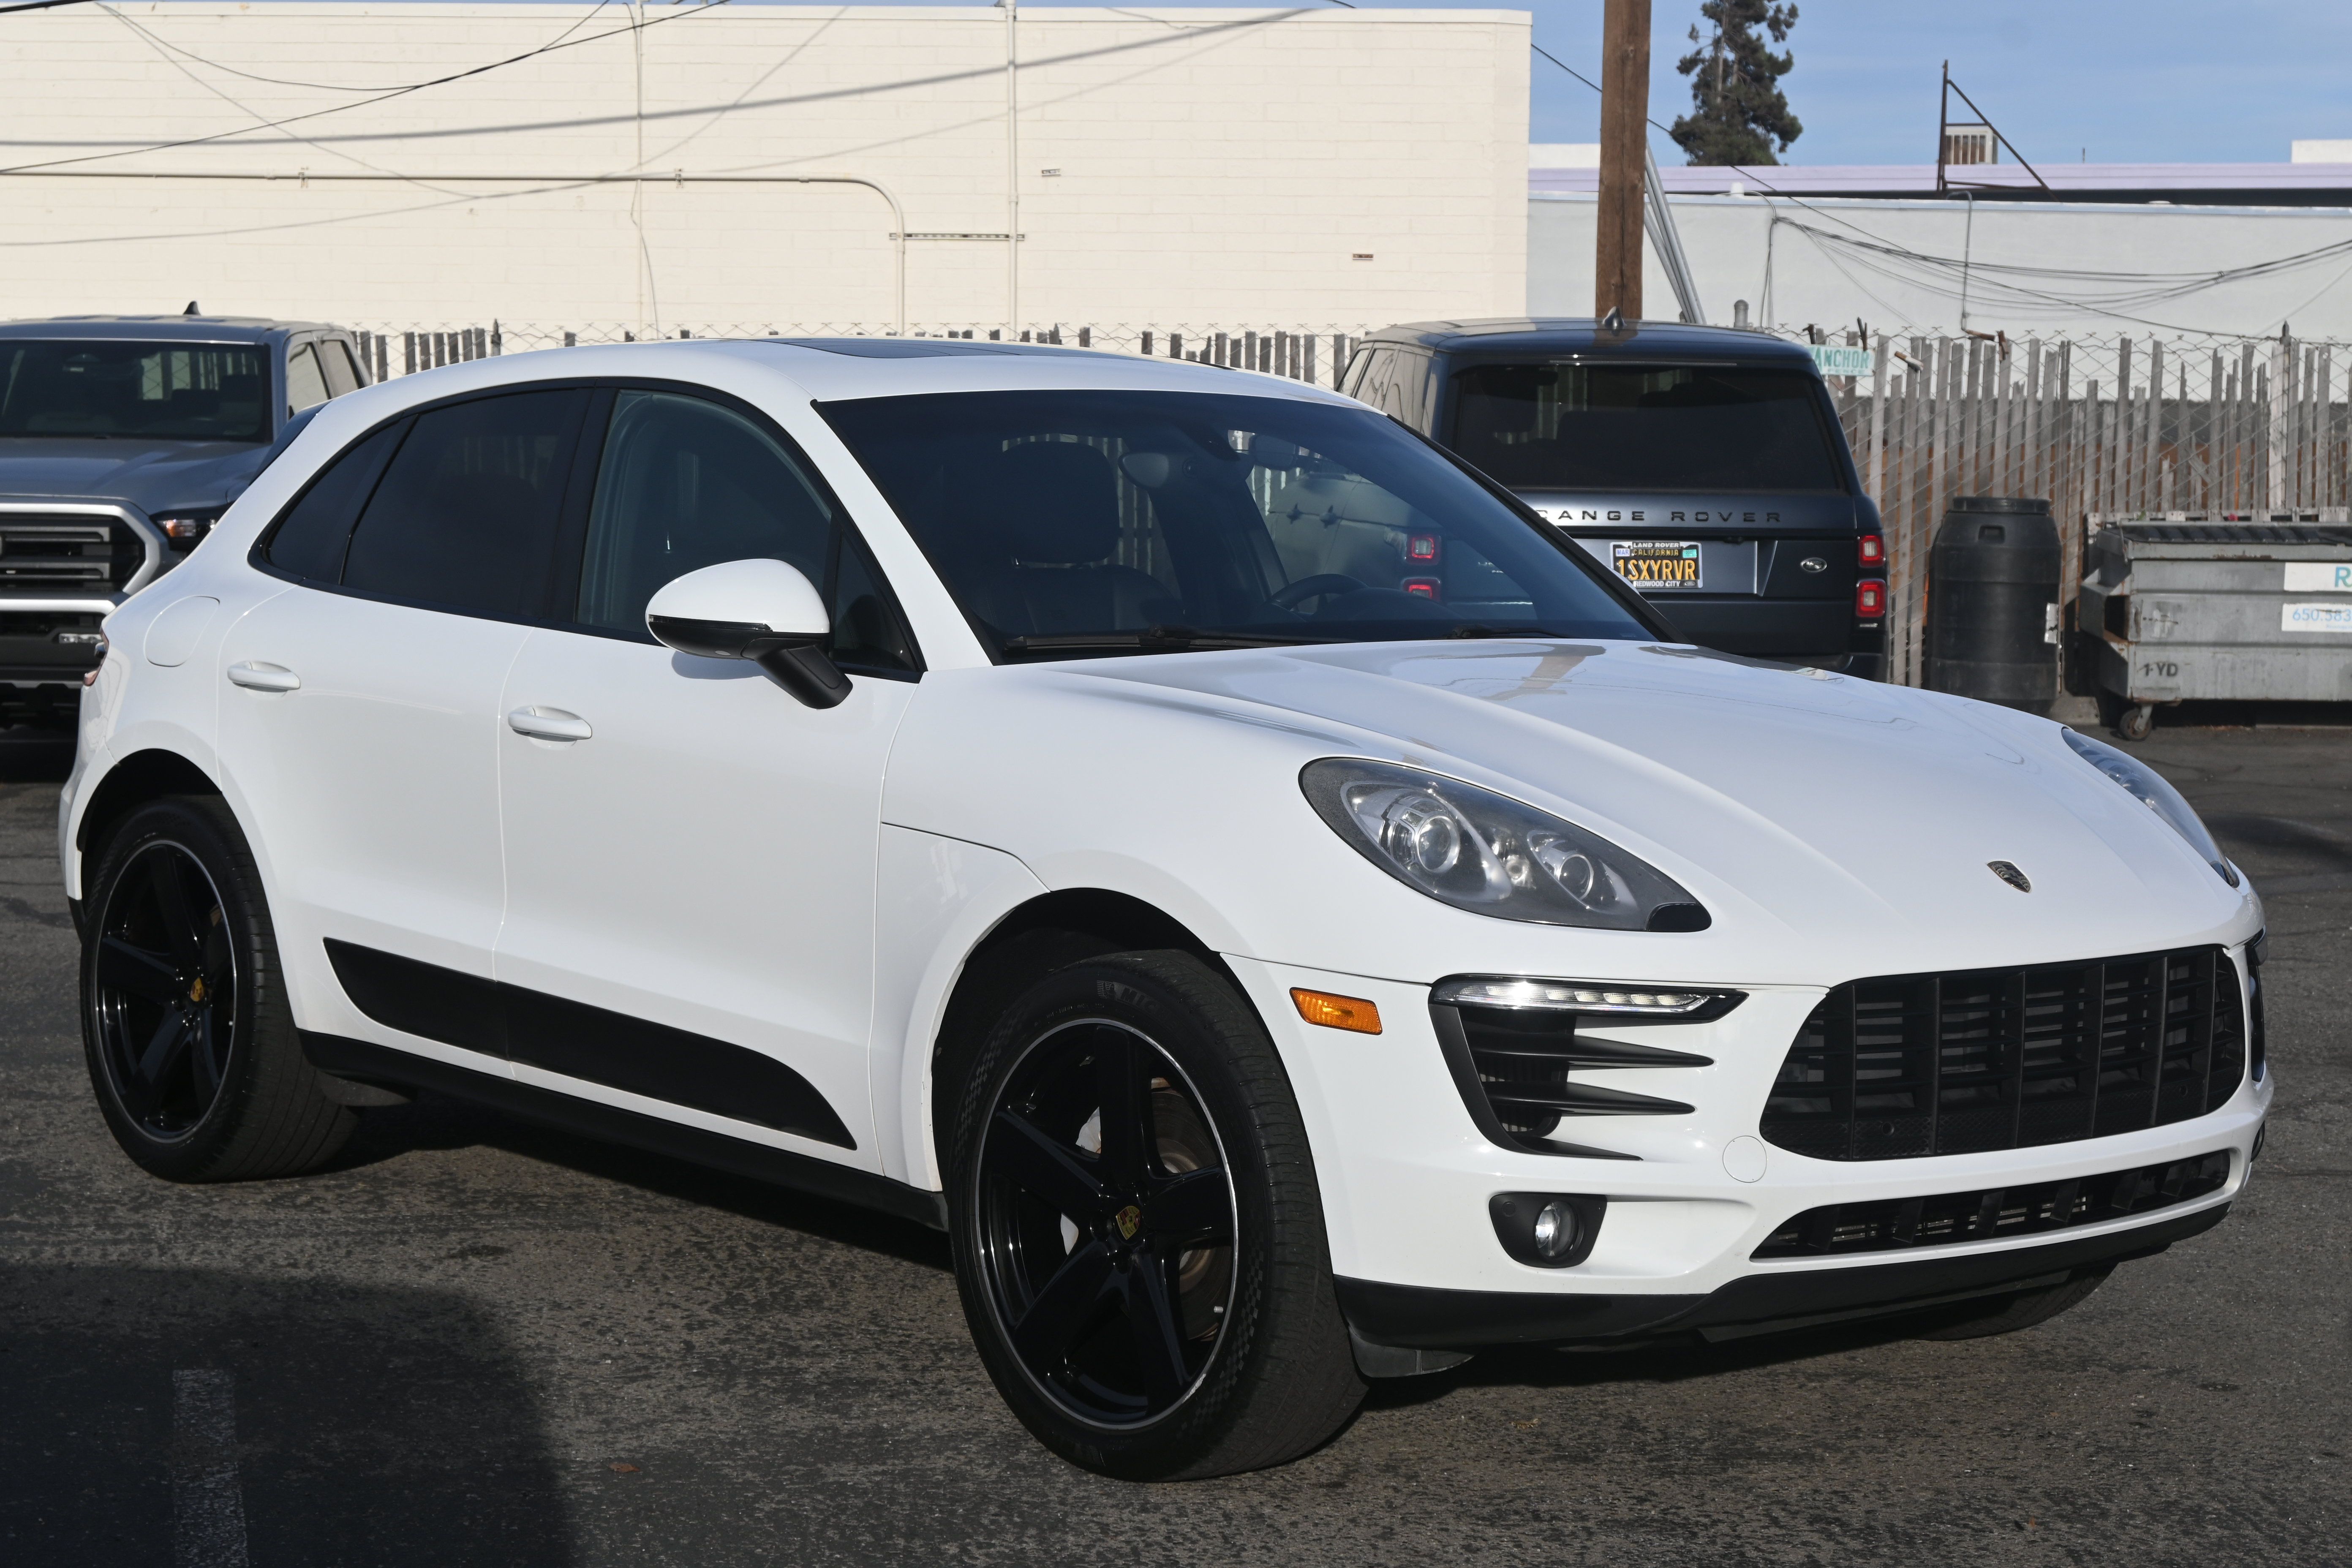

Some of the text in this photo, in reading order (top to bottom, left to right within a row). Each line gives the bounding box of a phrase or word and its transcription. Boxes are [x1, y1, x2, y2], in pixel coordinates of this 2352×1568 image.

[1814, 346, 1870, 371] ANCHOR
[1671, 511, 1780, 522] ROVER
[1618, 559, 1696, 580] 1SXYRVR
